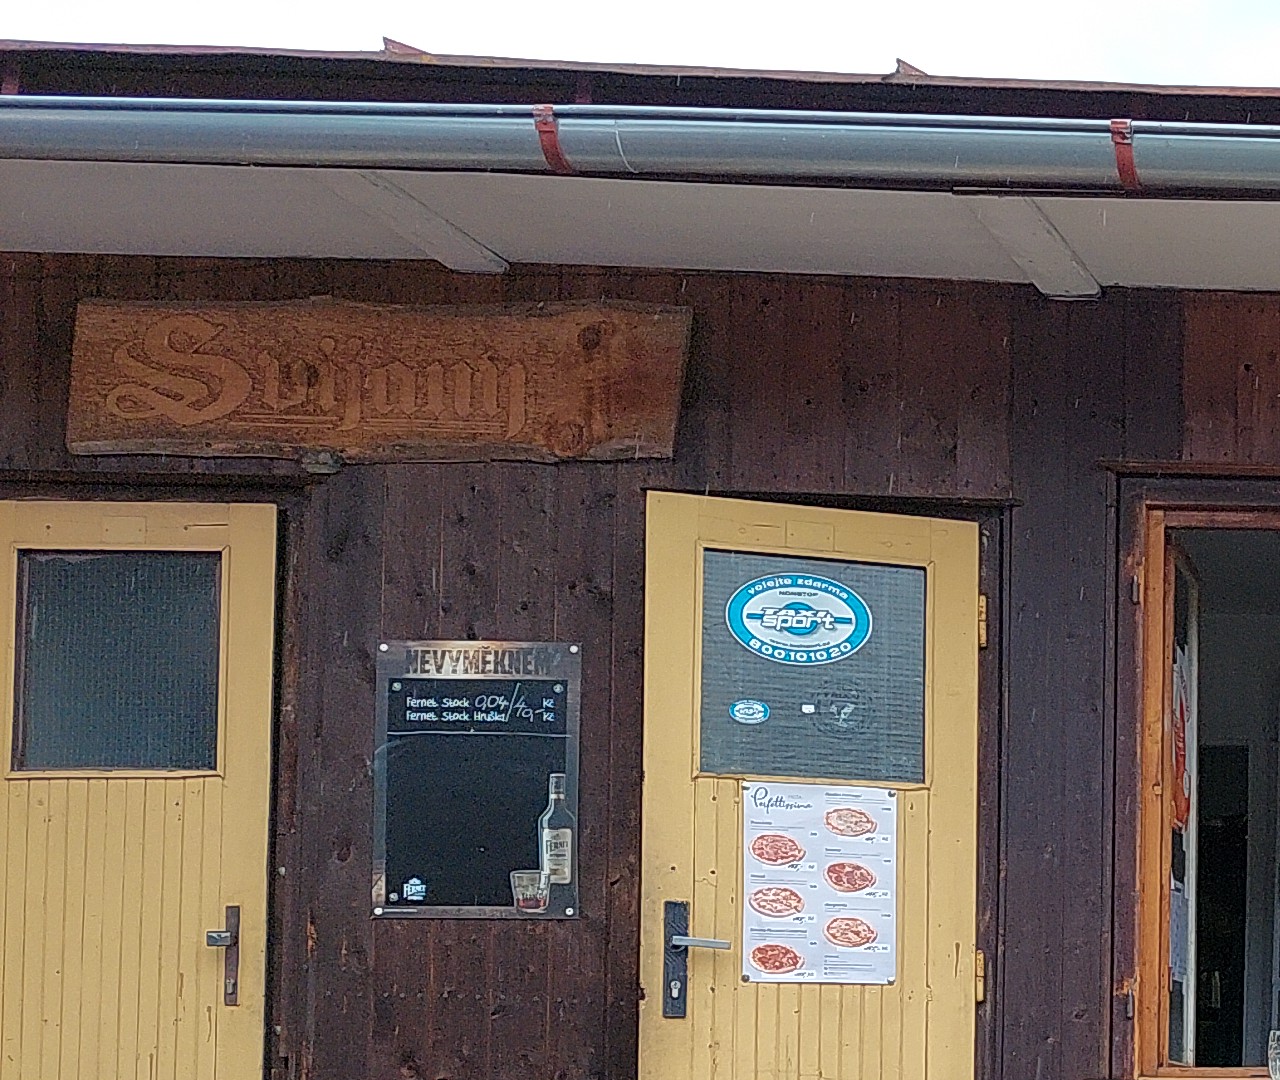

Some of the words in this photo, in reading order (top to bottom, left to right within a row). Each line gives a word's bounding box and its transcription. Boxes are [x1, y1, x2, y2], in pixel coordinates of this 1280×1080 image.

[747, 578, 792, 595] volejte
[796, 578, 849, 600] zdarma
[762, 608, 827, 618] TAXI
[762, 614, 835, 630] sport
[406, 697, 439, 708] Fernet
[441, 697, 470, 708] Stock
[406, 711, 439, 721] Fernet
[441, 711, 470, 721] Stock
[473, 711, 506, 721] Hruška
